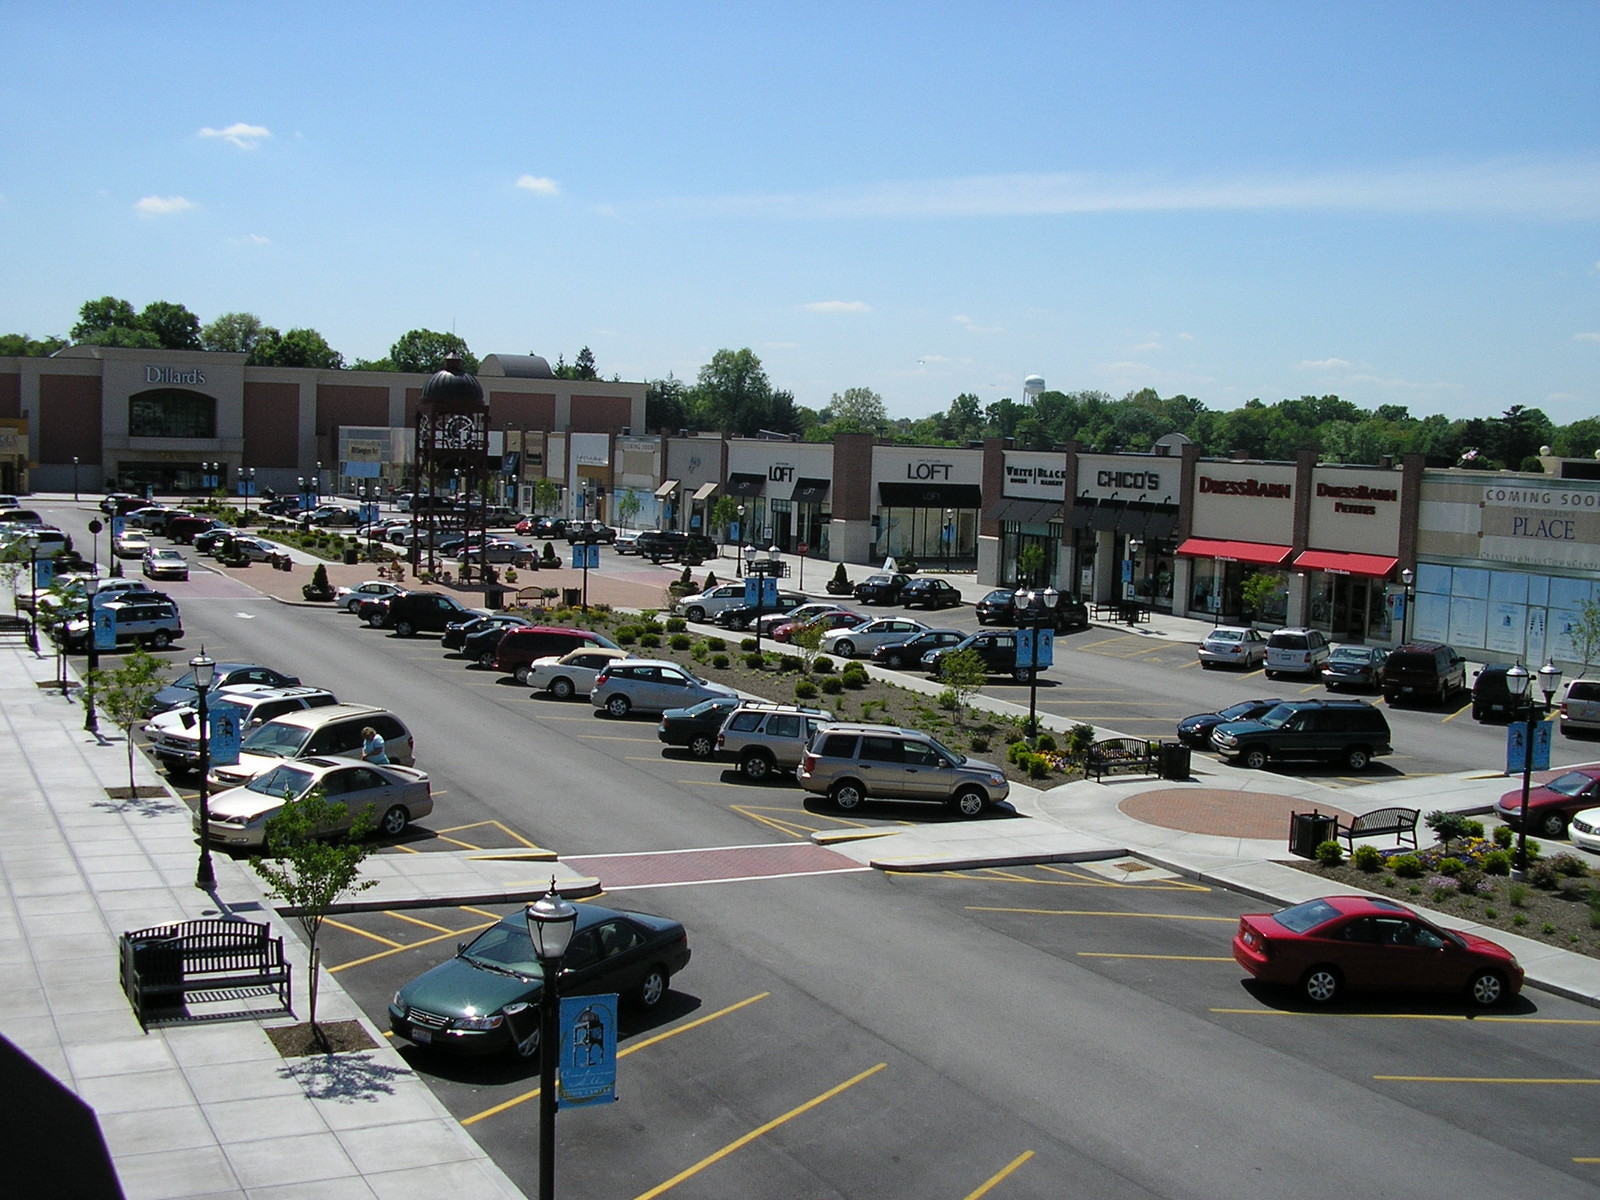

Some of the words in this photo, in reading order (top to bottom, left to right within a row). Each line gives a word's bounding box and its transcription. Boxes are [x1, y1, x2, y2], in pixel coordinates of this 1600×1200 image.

[145, 366, 206, 385] Dillard's
[769, 466, 795, 483] LOFT
[907, 463, 953, 480] LOFT
[1006, 466, 1033, 477] WHITE
[1097, 470, 1159, 490] CHICO'S
[1486, 489, 1551, 504] COMING
[1512, 516, 1576, 540] PLACE
